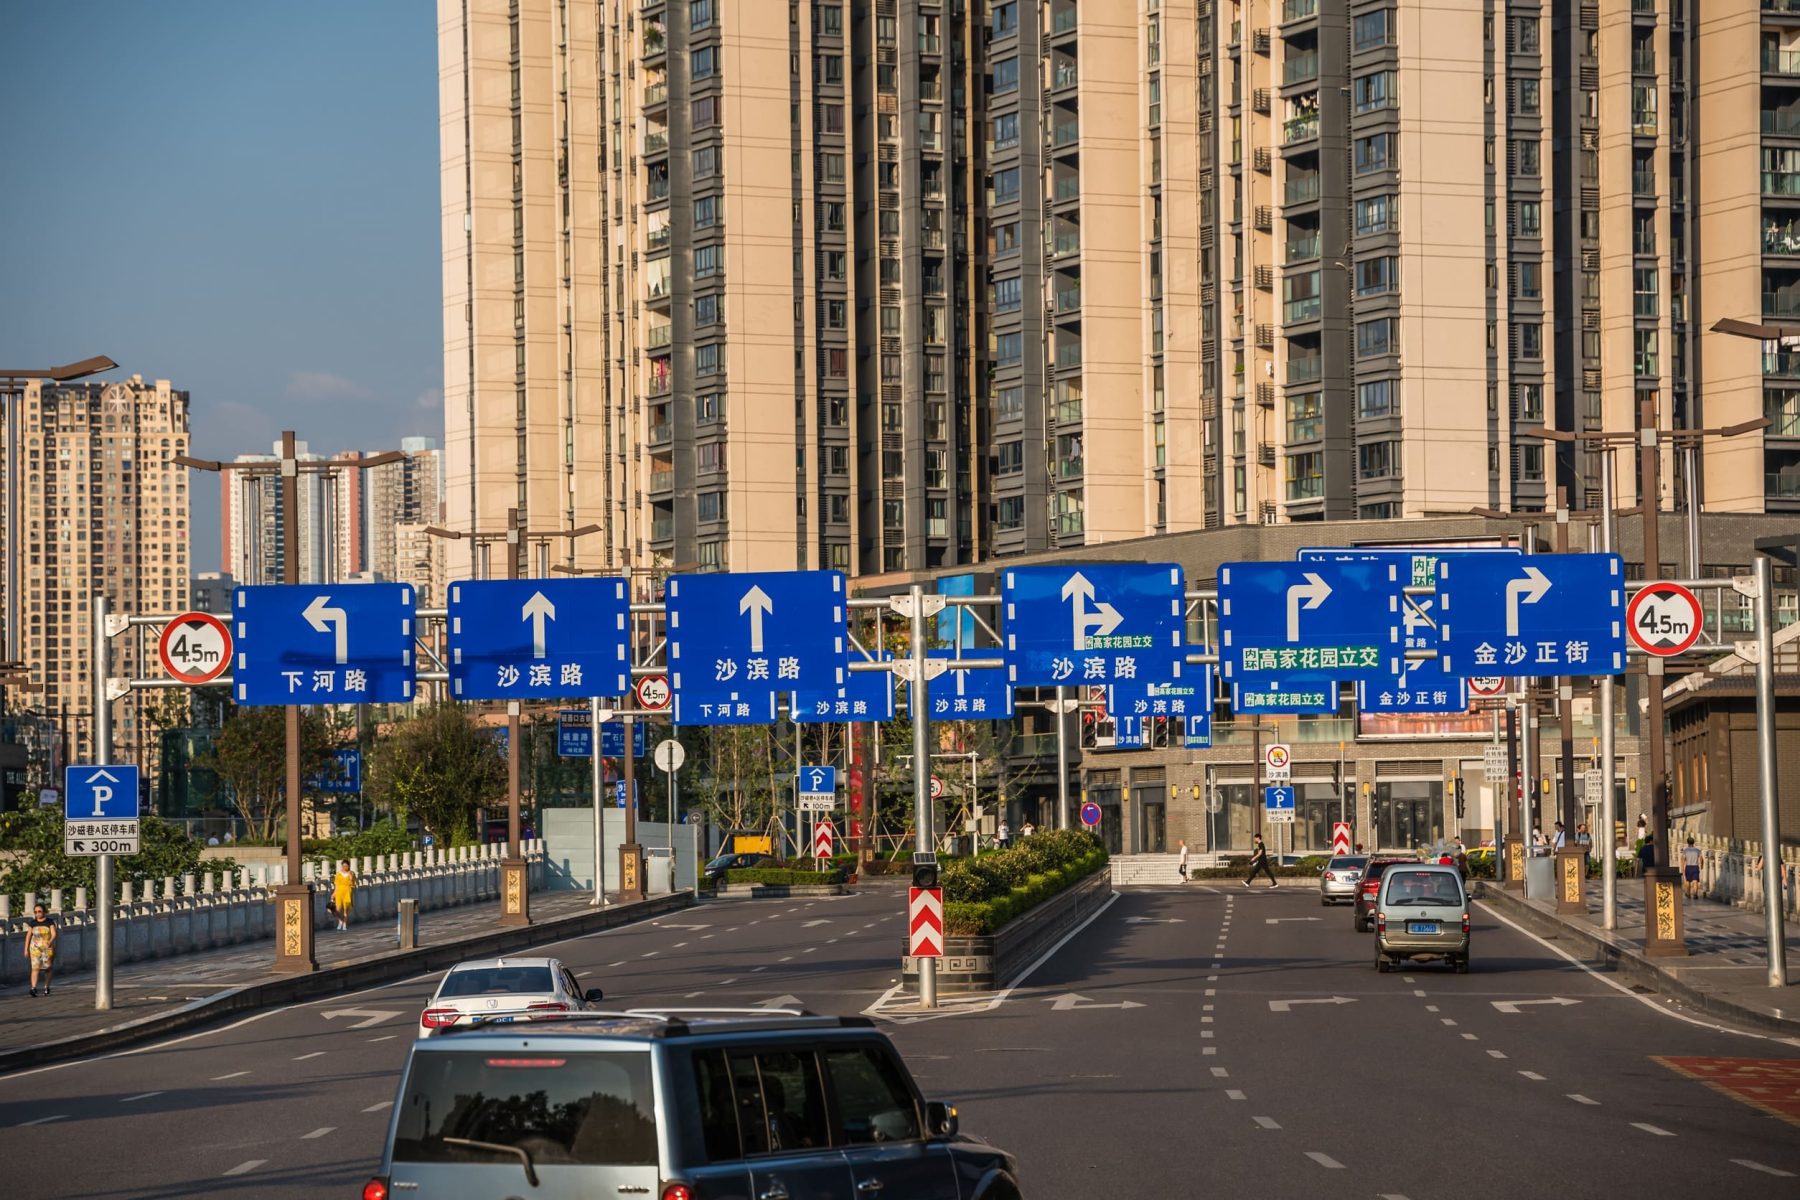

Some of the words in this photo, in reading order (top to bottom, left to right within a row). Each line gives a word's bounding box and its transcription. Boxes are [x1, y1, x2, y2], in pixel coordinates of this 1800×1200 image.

[1638, 605, 1689, 634] 4.5m
[170, 634, 219, 662] 4.5m
[1473, 640, 1589, 665] 金沙正街
[497, 663, 583, 687] 沙滨路
[715, 656, 801, 681] 沙滨路
[1051, 656, 1137, 680] 沙滨路
[281, 669, 367, 693] 下河路
[642, 685, 666, 699] 4.5m
[1379, 691, 1447, 706] 金沙正街
[700, 703, 751, 717] 下河路
[816, 701, 867, 715] 沙滨路
[935, 698, 986, 713] 沙滨路
[1134, 699, 1186, 714] 沙滨路
[92, 786, 113, 816] P
[67, 824, 137, 836] 沙磁巷A区停车库
[91, 841, 131, 852] 300m
